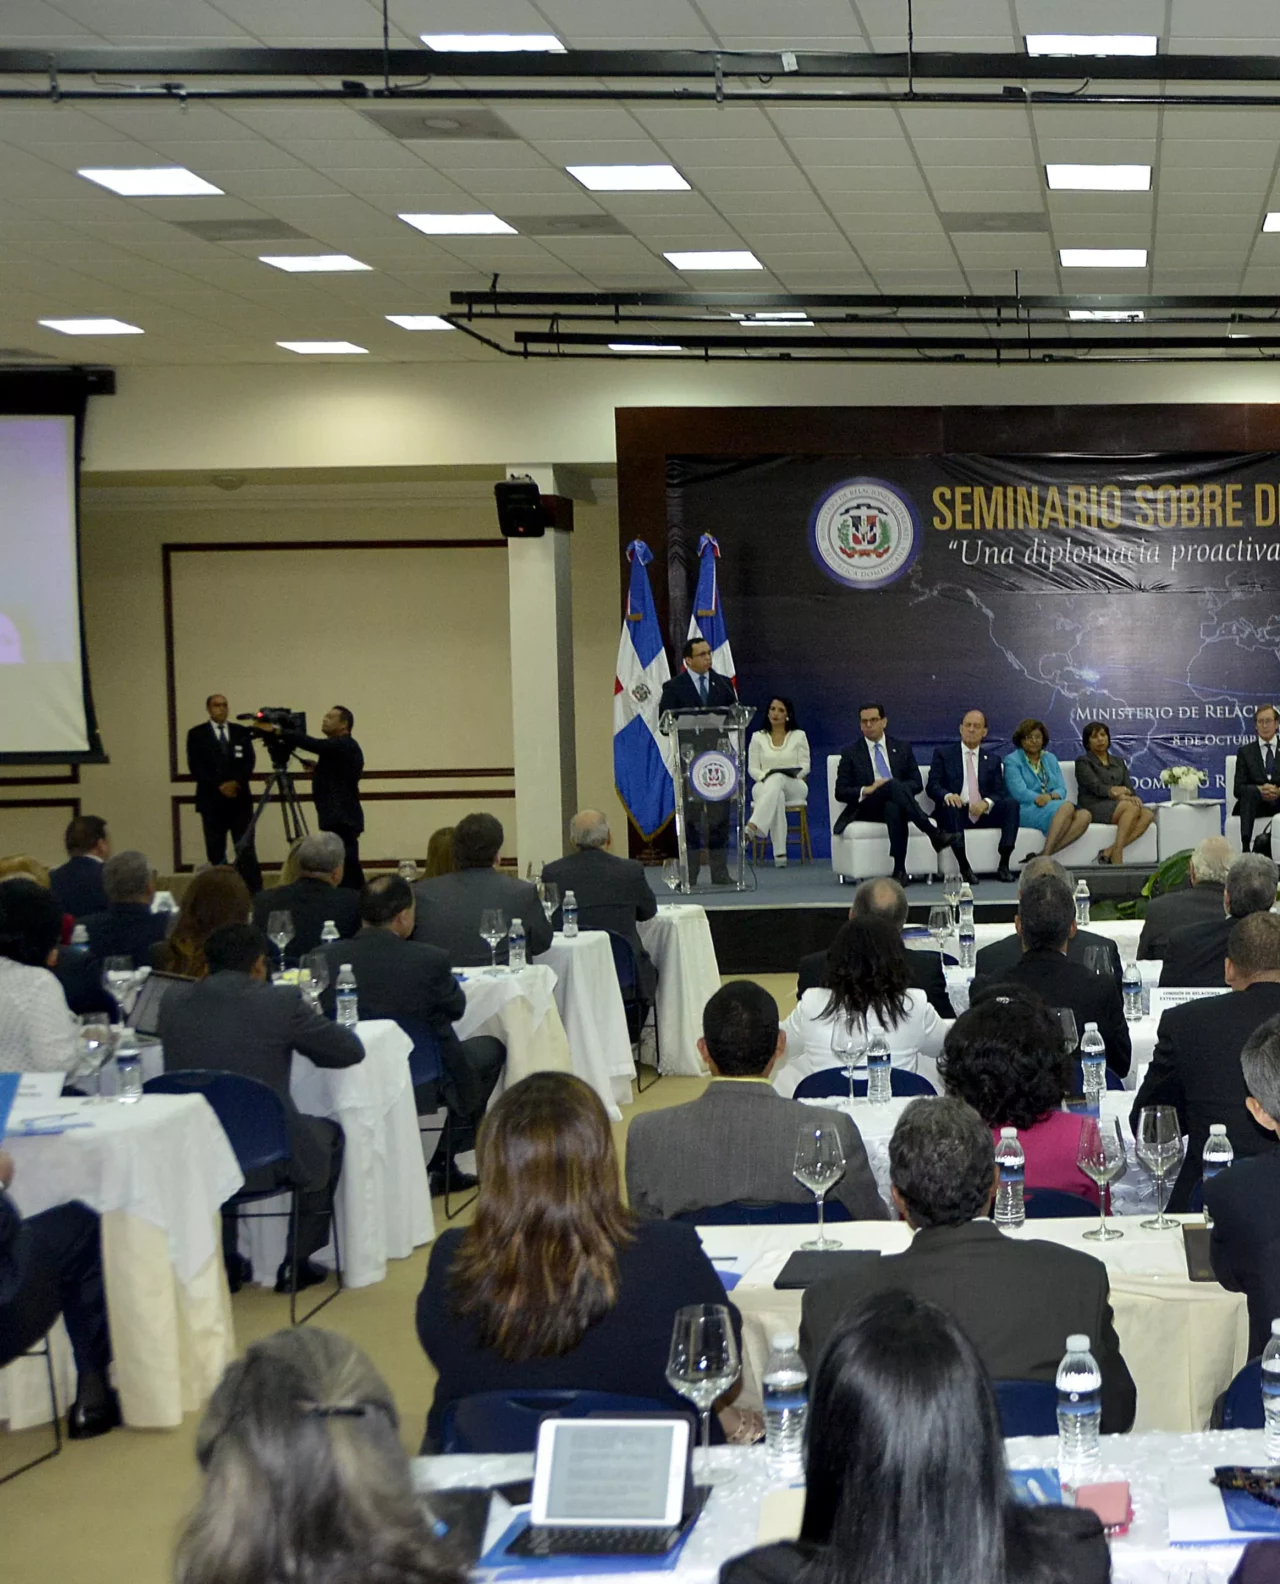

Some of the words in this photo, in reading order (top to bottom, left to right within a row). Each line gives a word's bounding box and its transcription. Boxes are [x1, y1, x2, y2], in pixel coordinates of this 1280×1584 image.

[932, 485, 1121, 531] SEMINARIO
[1135, 483, 1243, 529] SOBRE
[1024, 538, 1160, 571] diplomacia
[1170, 537, 1280, 571] proactiva
[1076, 706, 1173, 720] MINISTERIO
[1179, 706, 1199, 719] DE
[1185, 735, 1201, 746] DE
[1205, 734, 1257, 746] OCTUBR
